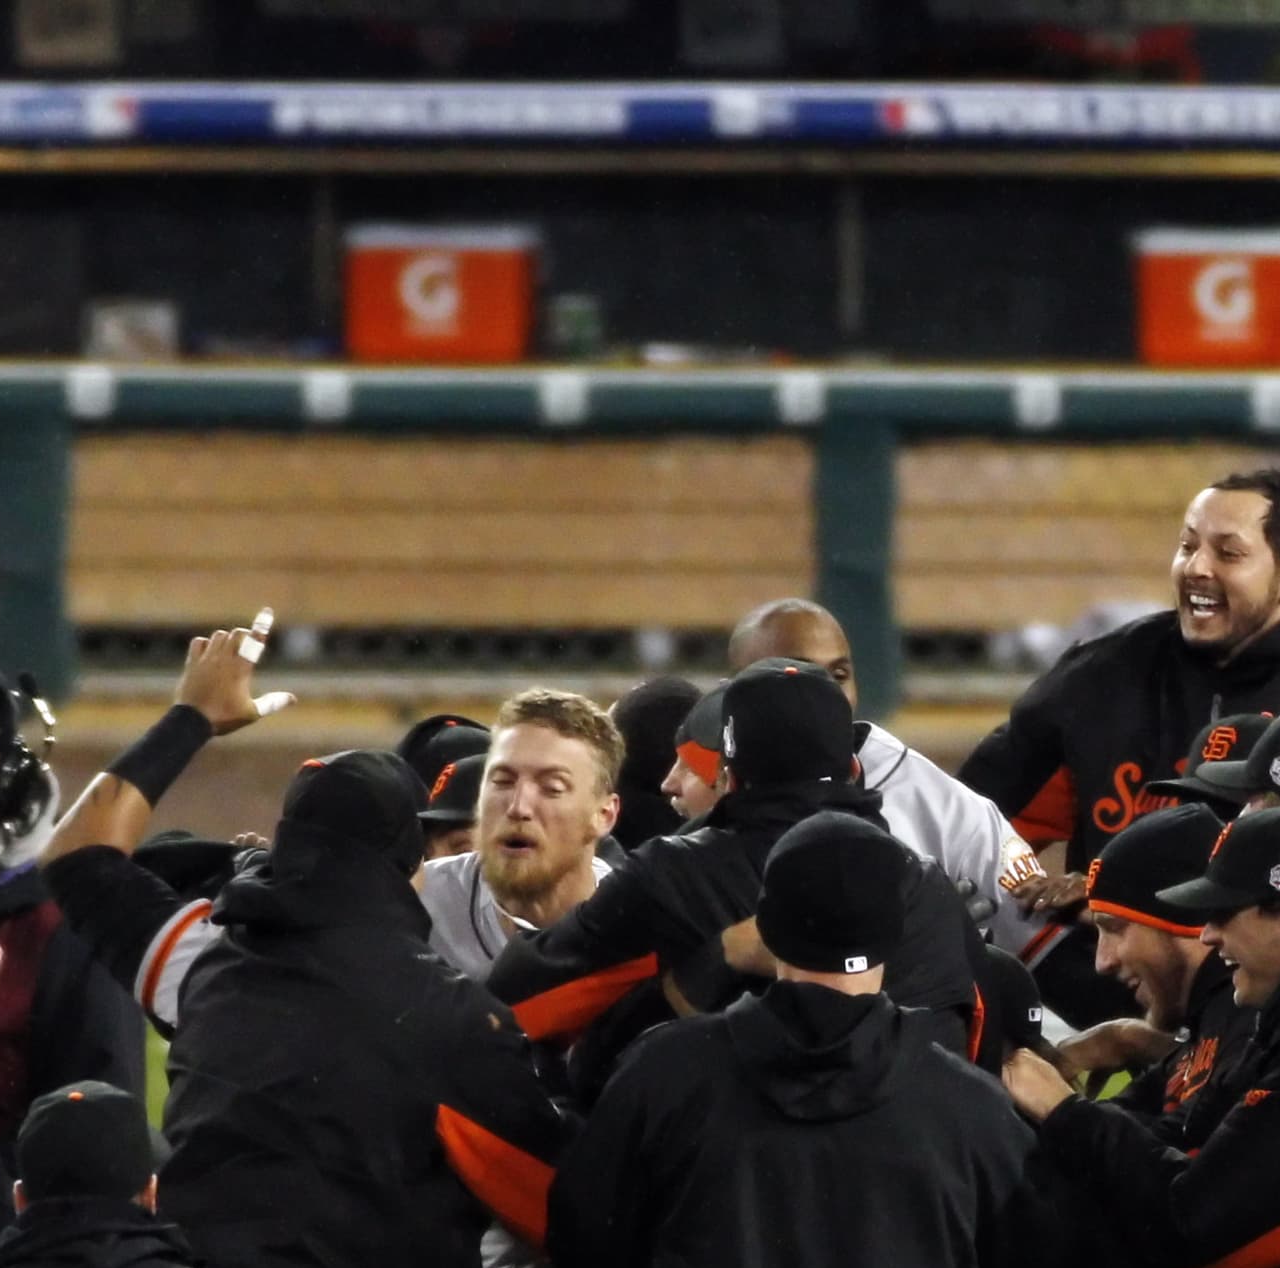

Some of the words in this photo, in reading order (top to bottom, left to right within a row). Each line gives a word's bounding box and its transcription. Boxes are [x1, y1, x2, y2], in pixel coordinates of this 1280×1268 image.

[950, 99, 1129, 135] WORLD
[400, 255, 460, 320] G
[1195, 261, 1255, 323] G
